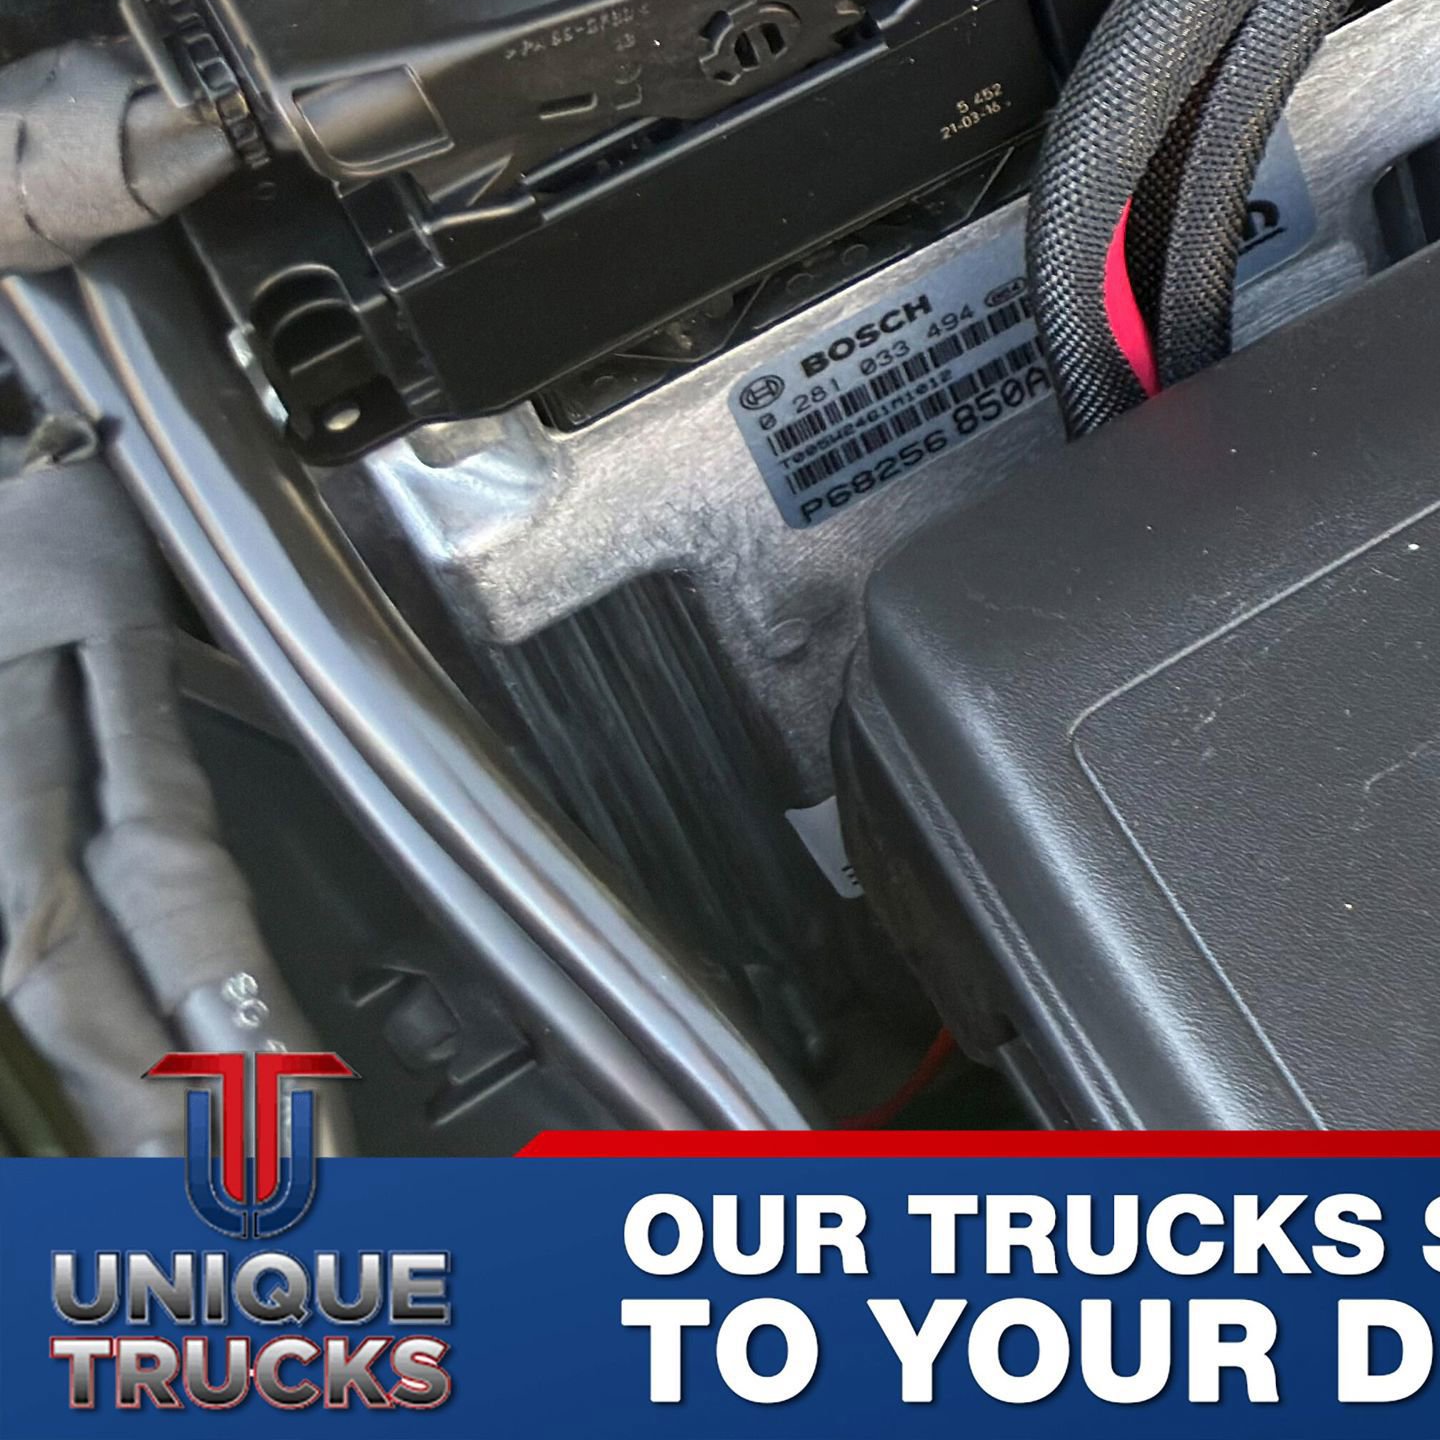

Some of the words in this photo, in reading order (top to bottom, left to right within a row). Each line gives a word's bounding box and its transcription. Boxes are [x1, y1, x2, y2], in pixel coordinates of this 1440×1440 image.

[940, 100, 1002, 140] 21-03-16
[758, 412, 777, 431] 0
[791, 377, 841, 414] 281
[859, 339, 911, 376] 033
[926, 303, 975, 339] 494
[800, 293, 933, 378] BOSCH
